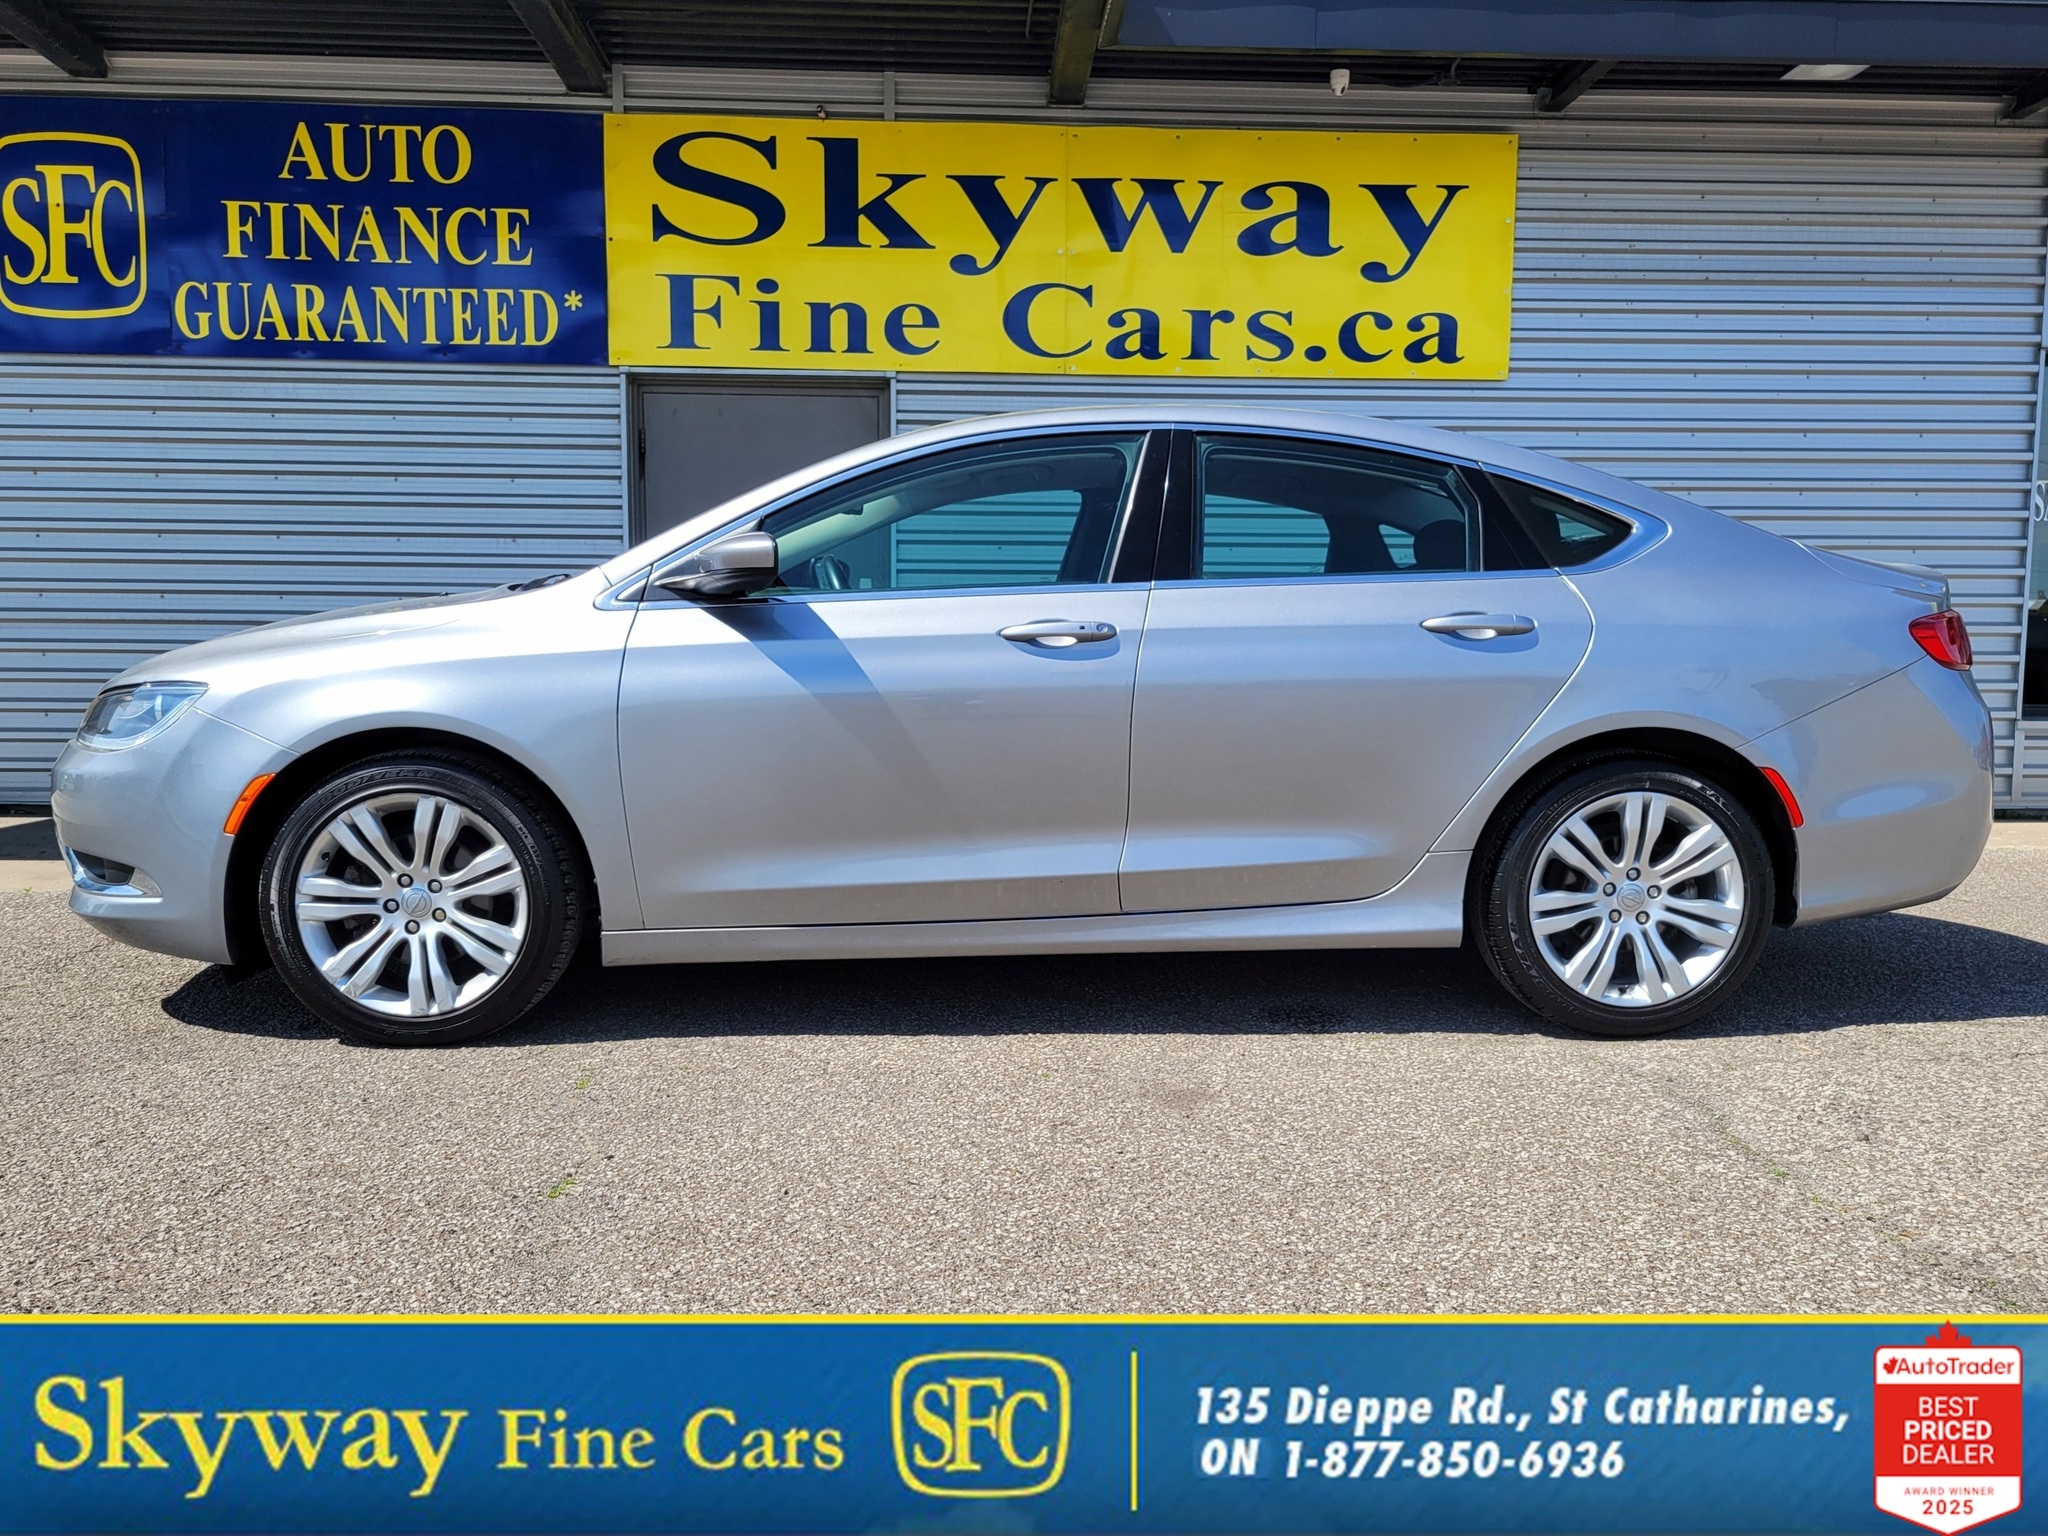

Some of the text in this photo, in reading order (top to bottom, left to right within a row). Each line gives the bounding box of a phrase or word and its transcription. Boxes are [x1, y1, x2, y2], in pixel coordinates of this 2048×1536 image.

[279, 121, 472, 184] AUTO
[2, 164, 137, 287] SFC
[221, 200, 533, 266] FINANCE
[651, 131, 1470, 283] Skyway
[656, 273, 1463, 363] Fine Cars.ca
